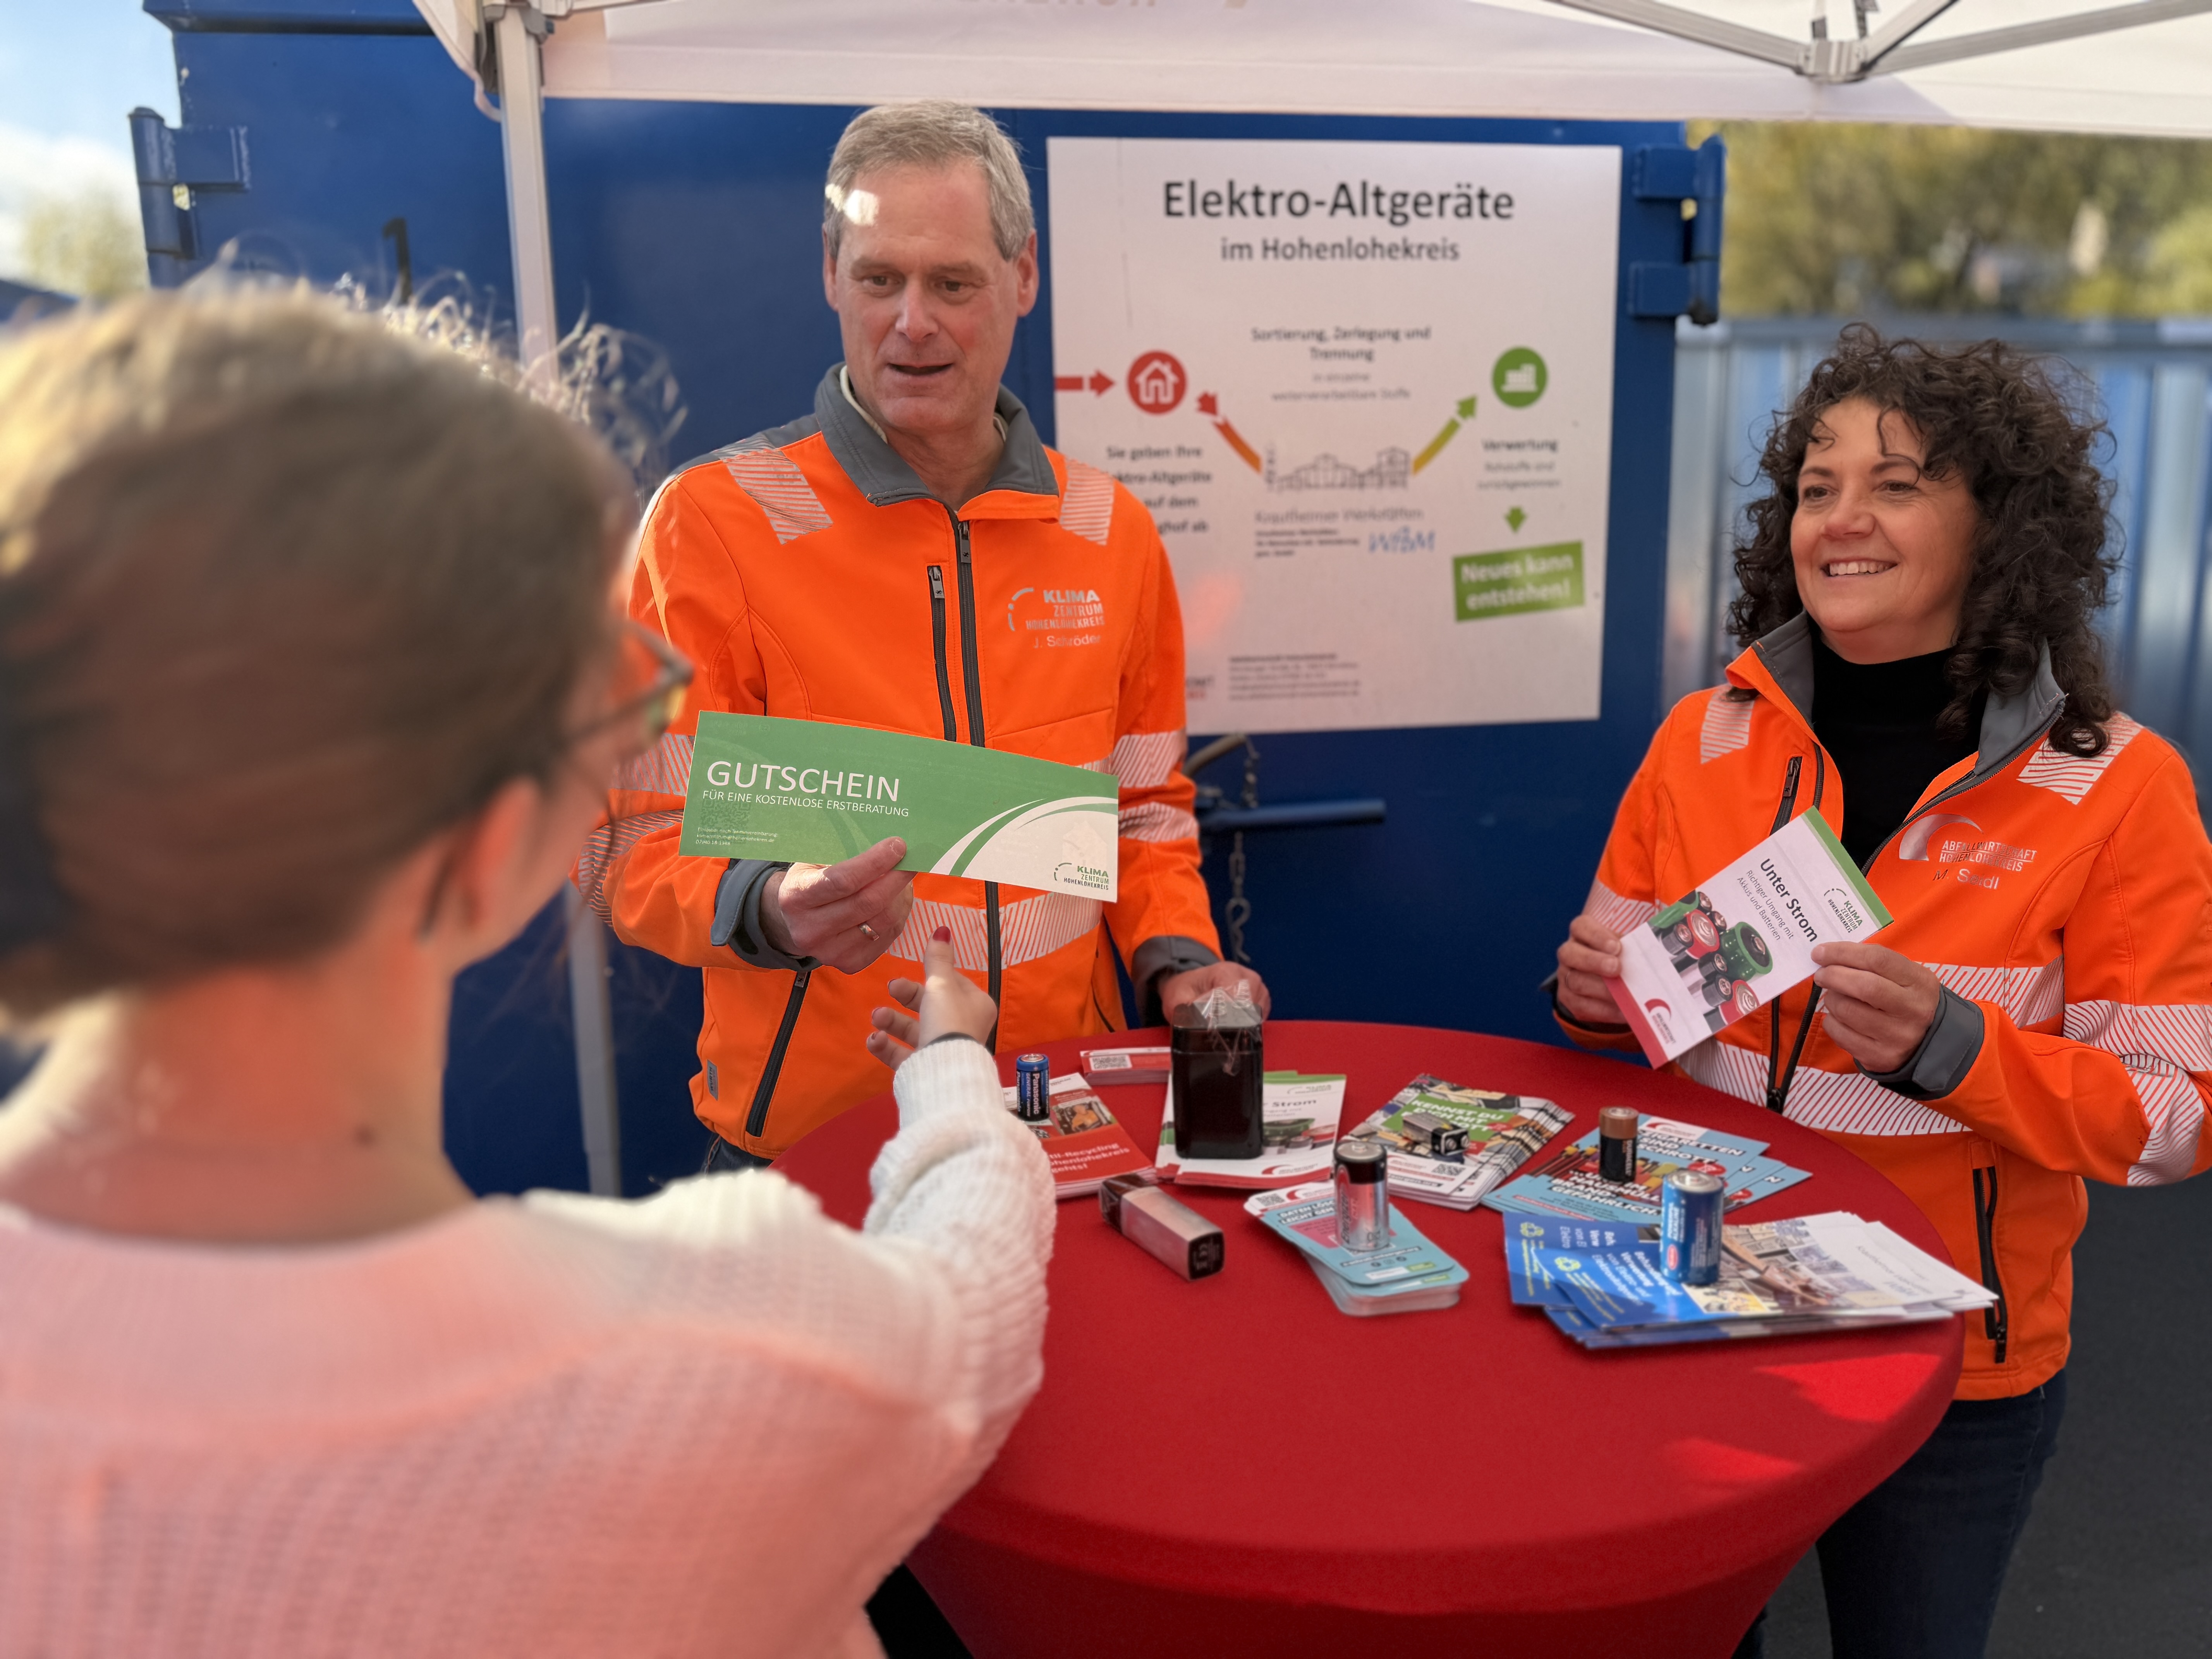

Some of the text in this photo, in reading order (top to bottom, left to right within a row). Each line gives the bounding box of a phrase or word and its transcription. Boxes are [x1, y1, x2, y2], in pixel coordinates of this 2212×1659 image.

[1165, 179, 1515, 227] Elektro-Altgeräte
[1222, 237, 1460, 260] im Hohenlohekreis
[1252, 326, 1432, 343] Sortierung, Zerlegung und
[1310, 347, 1374, 362] Trennung
[1107, 445, 1202, 461] Sie geben Ihre
[1482, 438, 1558, 454] Verwertung
[1113, 471, 1212, 487] ktro-Altgeräte
[1169, 495, 1198, 507] dem
[1192, 520, 1208, 533] ab
[1461, 553, 1574, 584] Neues kann
[1043, 590, 1101, 603] KLIMA
[1466, 579, 1570, 611] entstehen!
[1054, 603, 1104, 617] ZENTRUM
[1033, 634, 1101, 648] J. Schröder
[707, 761, 900, 802] GUTSCHEIN
[703, 789, 909, 817] FÜR EINE KOSTENLOSE ERSTBERATUNG
[1077, 866, 1109, 878] KLIMA
[1081, 874, 1109, 884] ZENTRUM
[1957, 869, 2000, 890] Seidl
[1064, 878, 1109, 890] HOHENLOHEKREIS
[1737, 877, 1781, 941] Akkus und Batterien
[1747, 870, 1795, 940] Richtiger Umgang mit
[1760, 859, 1818, 942] Unter Strom
[1828, 899, 1852, 933] HOHENLOHEKREIS
[1841, 908, 1858, 930] ZENTRUM
[1844, 900, 1863, 926] KLIMA
[1032, 1073, 1041, 1115] Panasonic
[1412, 1100, 1504, 1120] KENNST DU
[1455, 1113, 1488, 1125] MIT
[1049, 1143, 1120, 1159] til-Recycling
[1639, 1137, 1680, 1149] SIND
[1641, 1130, 1744, 1156] ZIGARETTEN
[1050, 1148, 1130, 1166] ohenlohekreis
[1625, 1140, 1633, 1176] DURACELL
[1551, 1178, 1618, 1197] BRAND-
[1569, 1176, 1661, 1202] HAUSMÜLL
[1625, 1182, 1648, 1190] IM
[1279, 1200, 1334, 1218] DATEN LÖSC
[1551, 1186, 1659, 1216] GEFÄHRLICH.
[1281, 1207, 1334, 1224] LEICHT GEM
[1341, 1190, 1351, 1245] Energizer
[1560, 1226, 1571, 1249] Elektro
[1577, 1240, 1587, 1249] El
[1590, 1229, 1600, 1247] Verw
[1607, 1253, 1619, 1265] von
[1635, 1286, 1652, 1297] und
[1620, 1251, 1654, 1287] Verwertung
[1634, 1251, 1670, 1286] Behandlung
